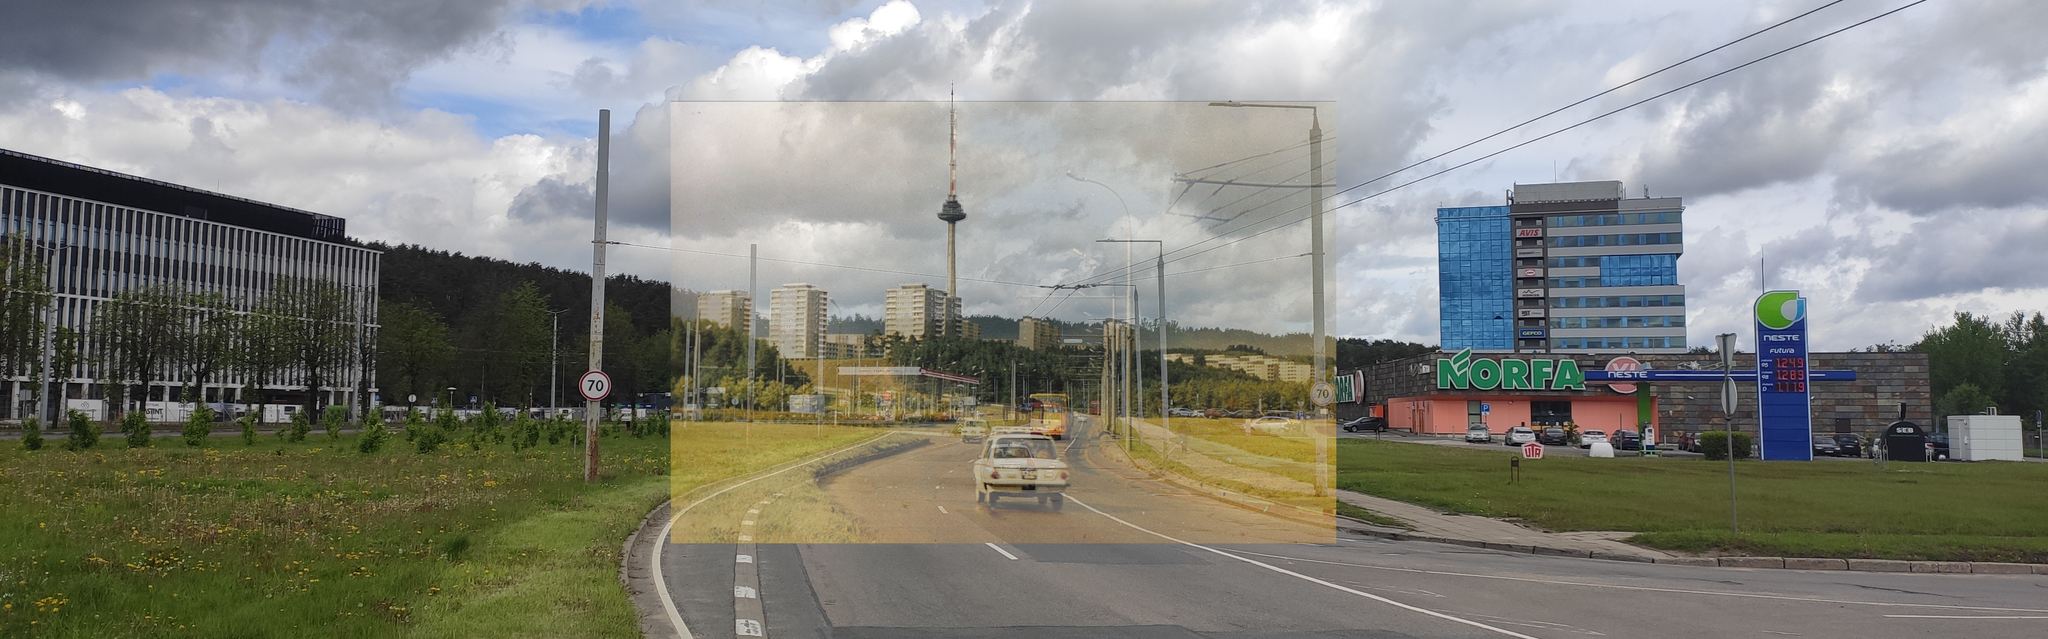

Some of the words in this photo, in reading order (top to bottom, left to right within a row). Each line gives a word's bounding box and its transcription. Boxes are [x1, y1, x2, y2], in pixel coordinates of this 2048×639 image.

[1763, 334, 1800, 342] NESTE
[1437, 348, 1585, 391] NORFA
[1608, 371, 1648, 379] NESTE
[587, 379, 604, 392] 70
[1316, 389, 1329, 399] 70
[1483, 404, 1489, 412] P
[1524, 443, 1542, 458] UTA
